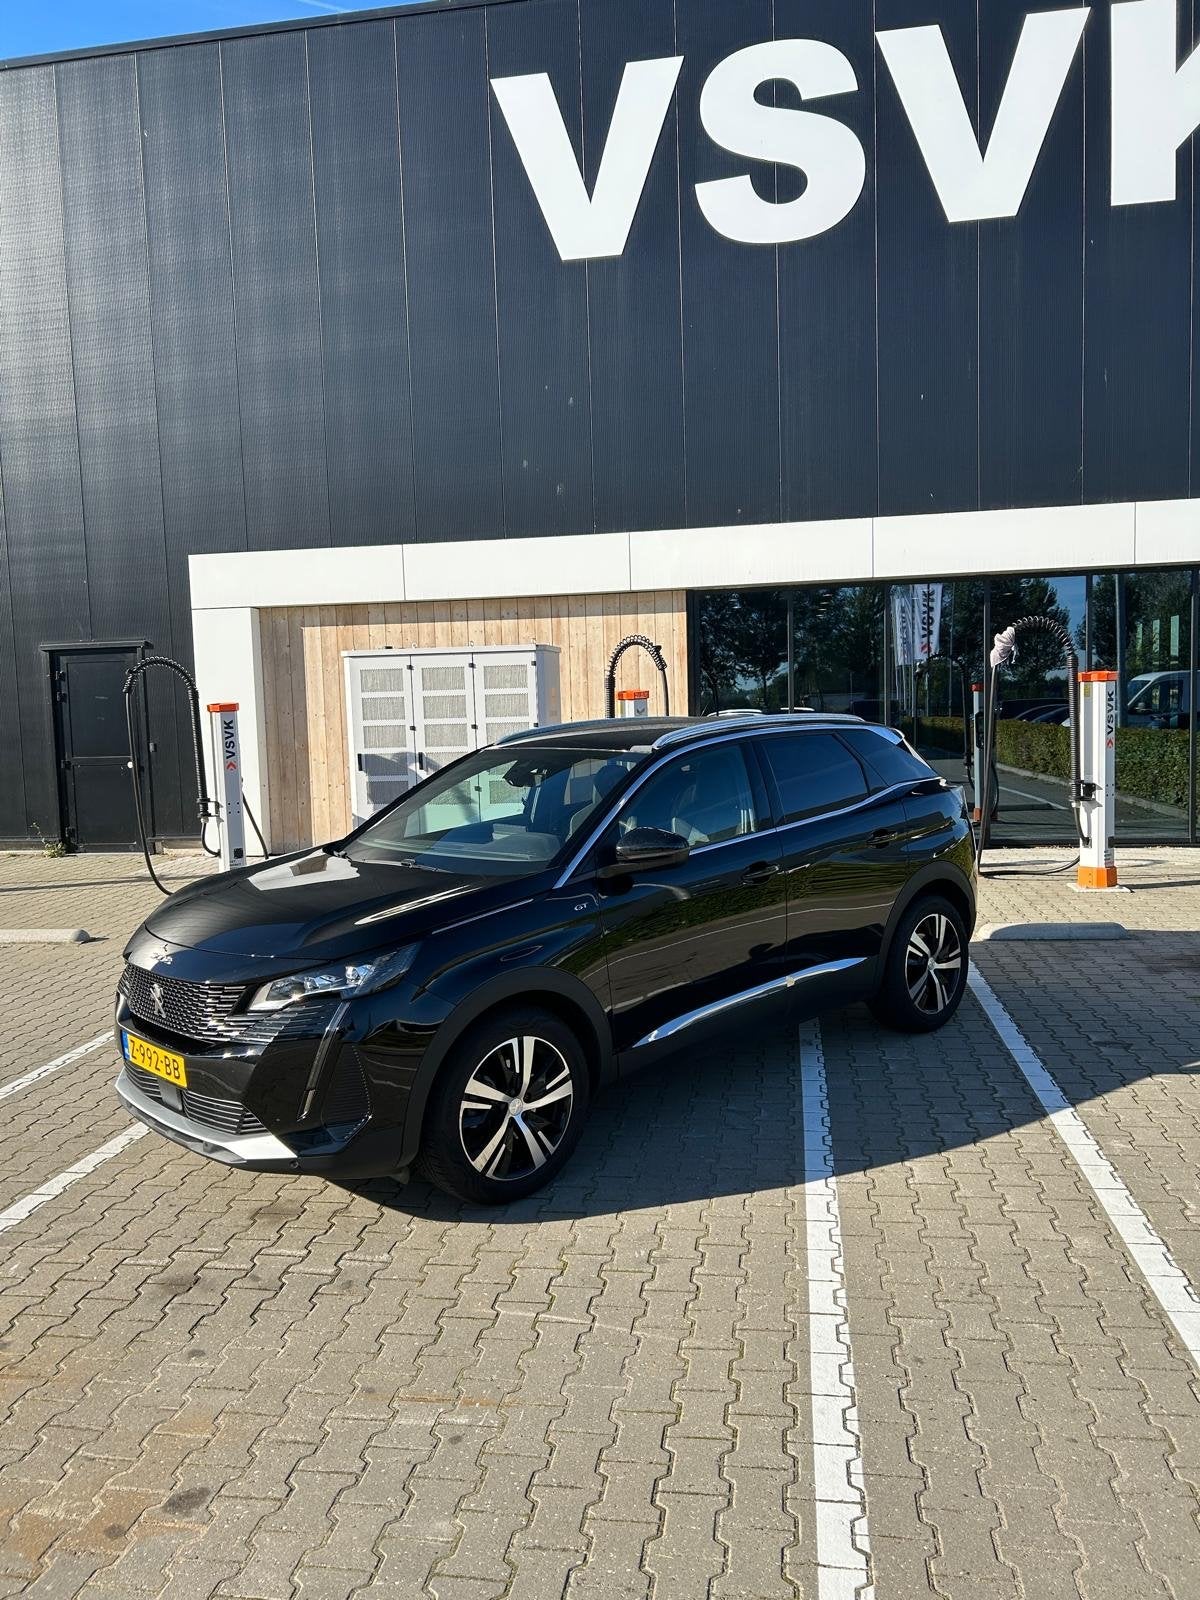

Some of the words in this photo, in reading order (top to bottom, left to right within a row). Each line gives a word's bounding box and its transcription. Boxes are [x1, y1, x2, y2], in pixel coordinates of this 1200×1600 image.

[490, 0, 1200, 261] VSVK
[1106, 691, 1115, 736] VSVK
[223, 719, 236, 760] VSVK
[130, 1039, 181, 1080] Z-992-BB
